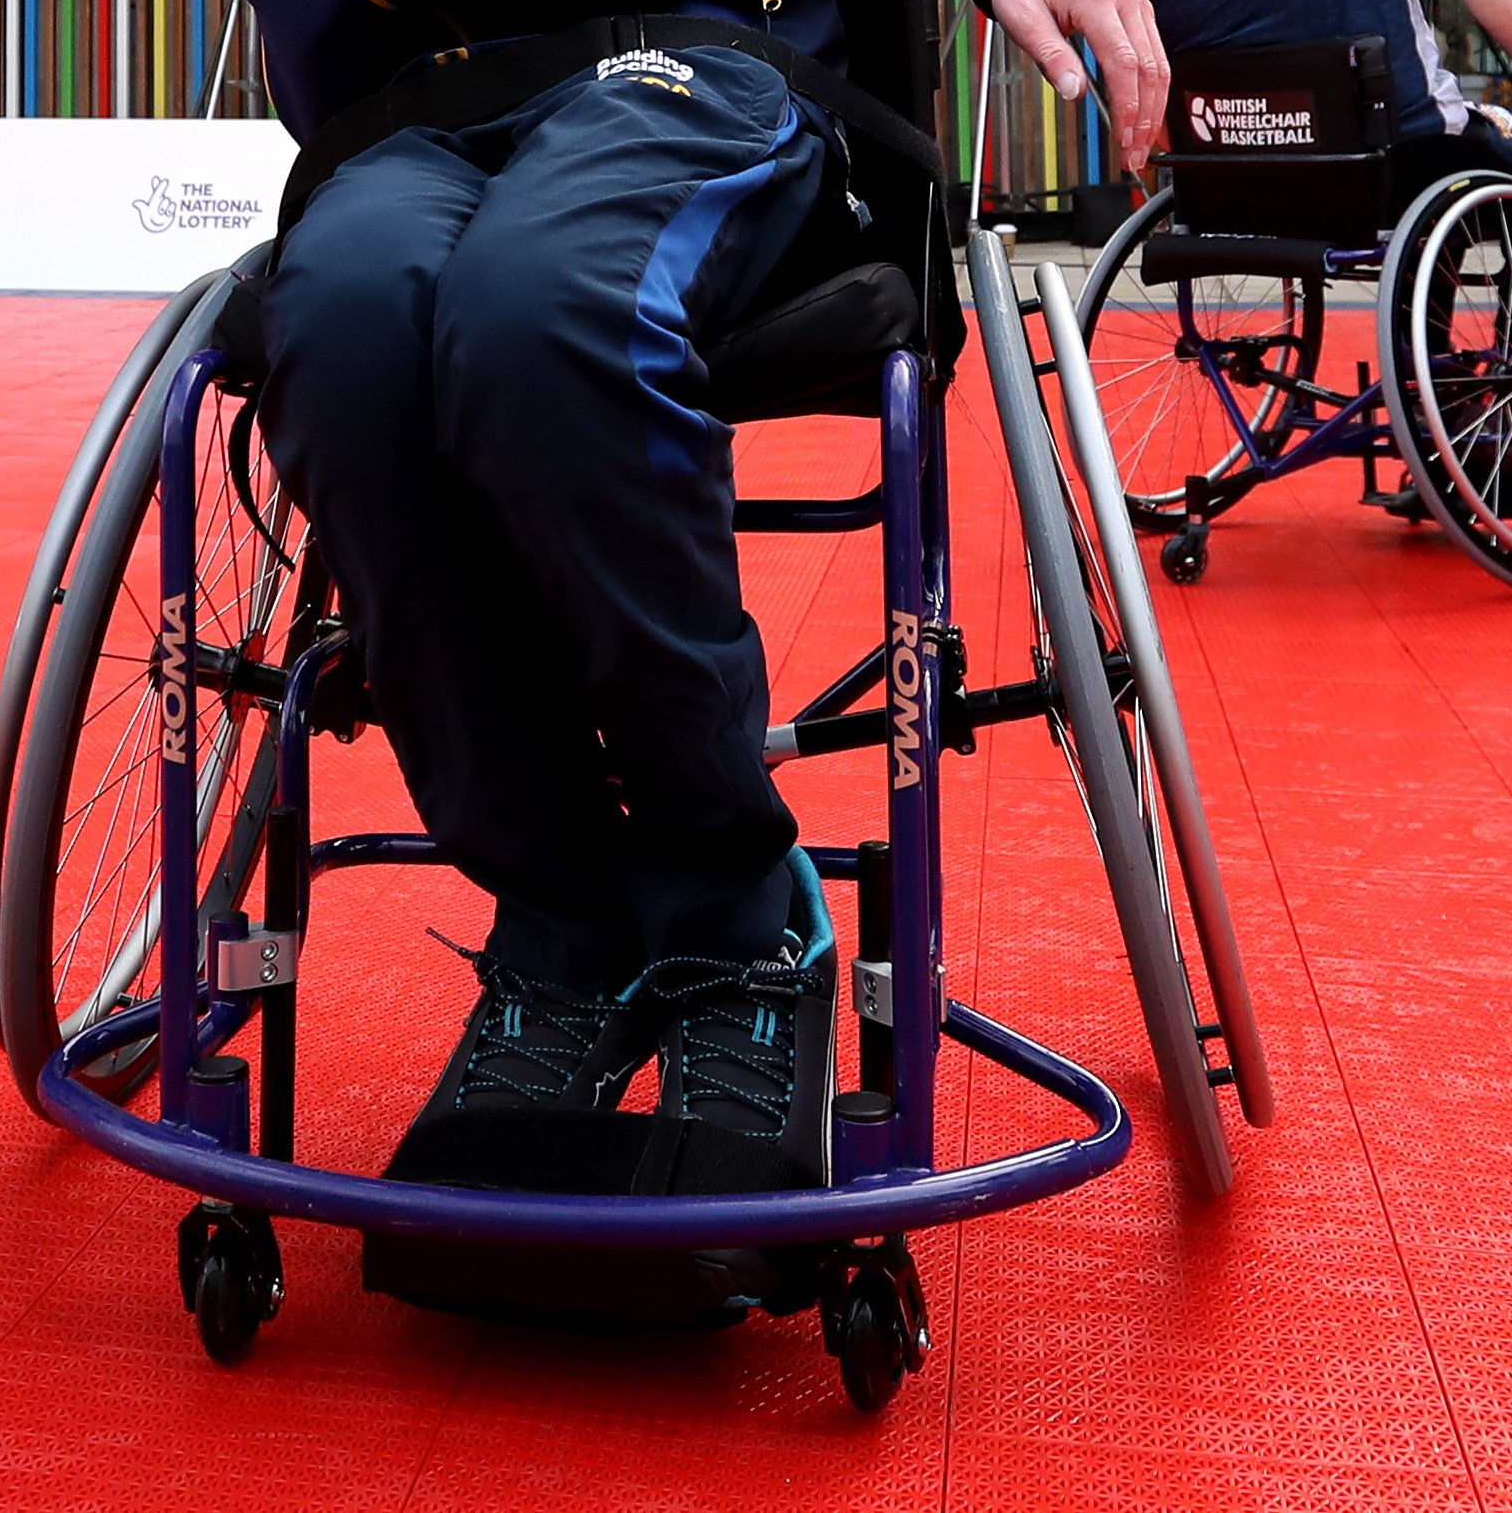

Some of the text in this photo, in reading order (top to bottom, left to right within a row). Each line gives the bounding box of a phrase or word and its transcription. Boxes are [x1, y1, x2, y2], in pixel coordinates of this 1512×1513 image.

[1214, 98, 1267, 114] BRITISH
[1217, 111, 1312, 130] WHEELCHAIR
[1221, 129, 1315, 146] BASKETBALL
[181, 183, 213, 197] THE
[180, 199, 263, 213] NATIONAL
[178, 215, 253, 229] LOTTERY
[162, 592, 187, 765] ROMA
[892, 608, 920, 791] ROMA
